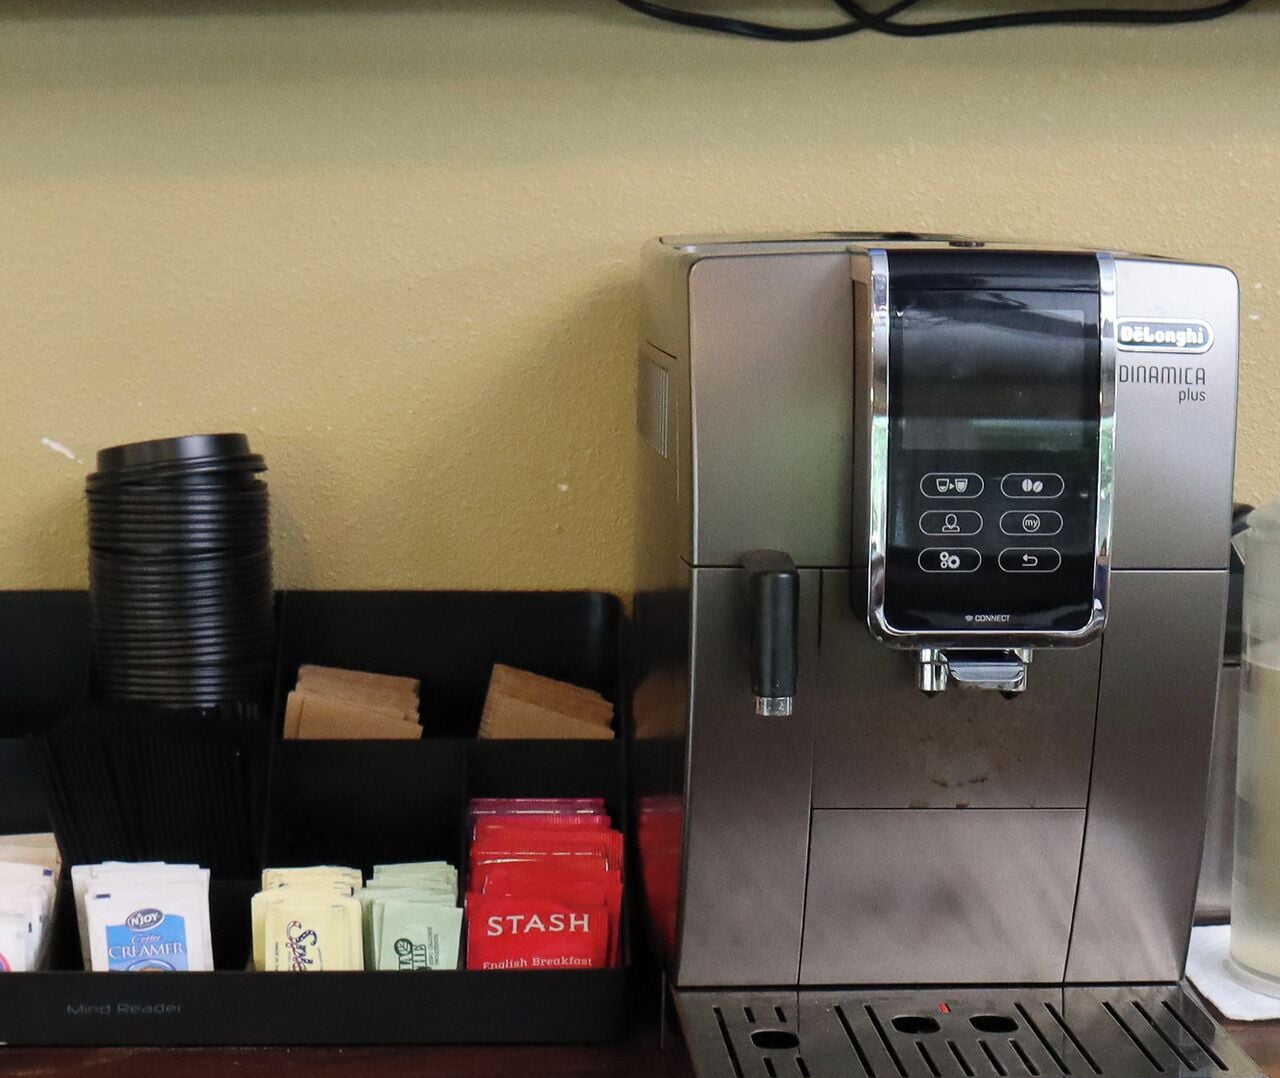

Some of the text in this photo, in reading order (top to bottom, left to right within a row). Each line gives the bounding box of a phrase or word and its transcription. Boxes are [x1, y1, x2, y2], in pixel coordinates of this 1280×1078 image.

[1119, 365, 1206, 385] DINAMICA
[1178, 388, 1206, 403] plus
[1024, 518, 1039, 529] my
[486, 914, 589, 937] STASH
[108, 943, 185, 959] CREAMER
[482, 956, 593, 969] English Breakfast
[67, 1004, 182, 1015] Mind Reader
